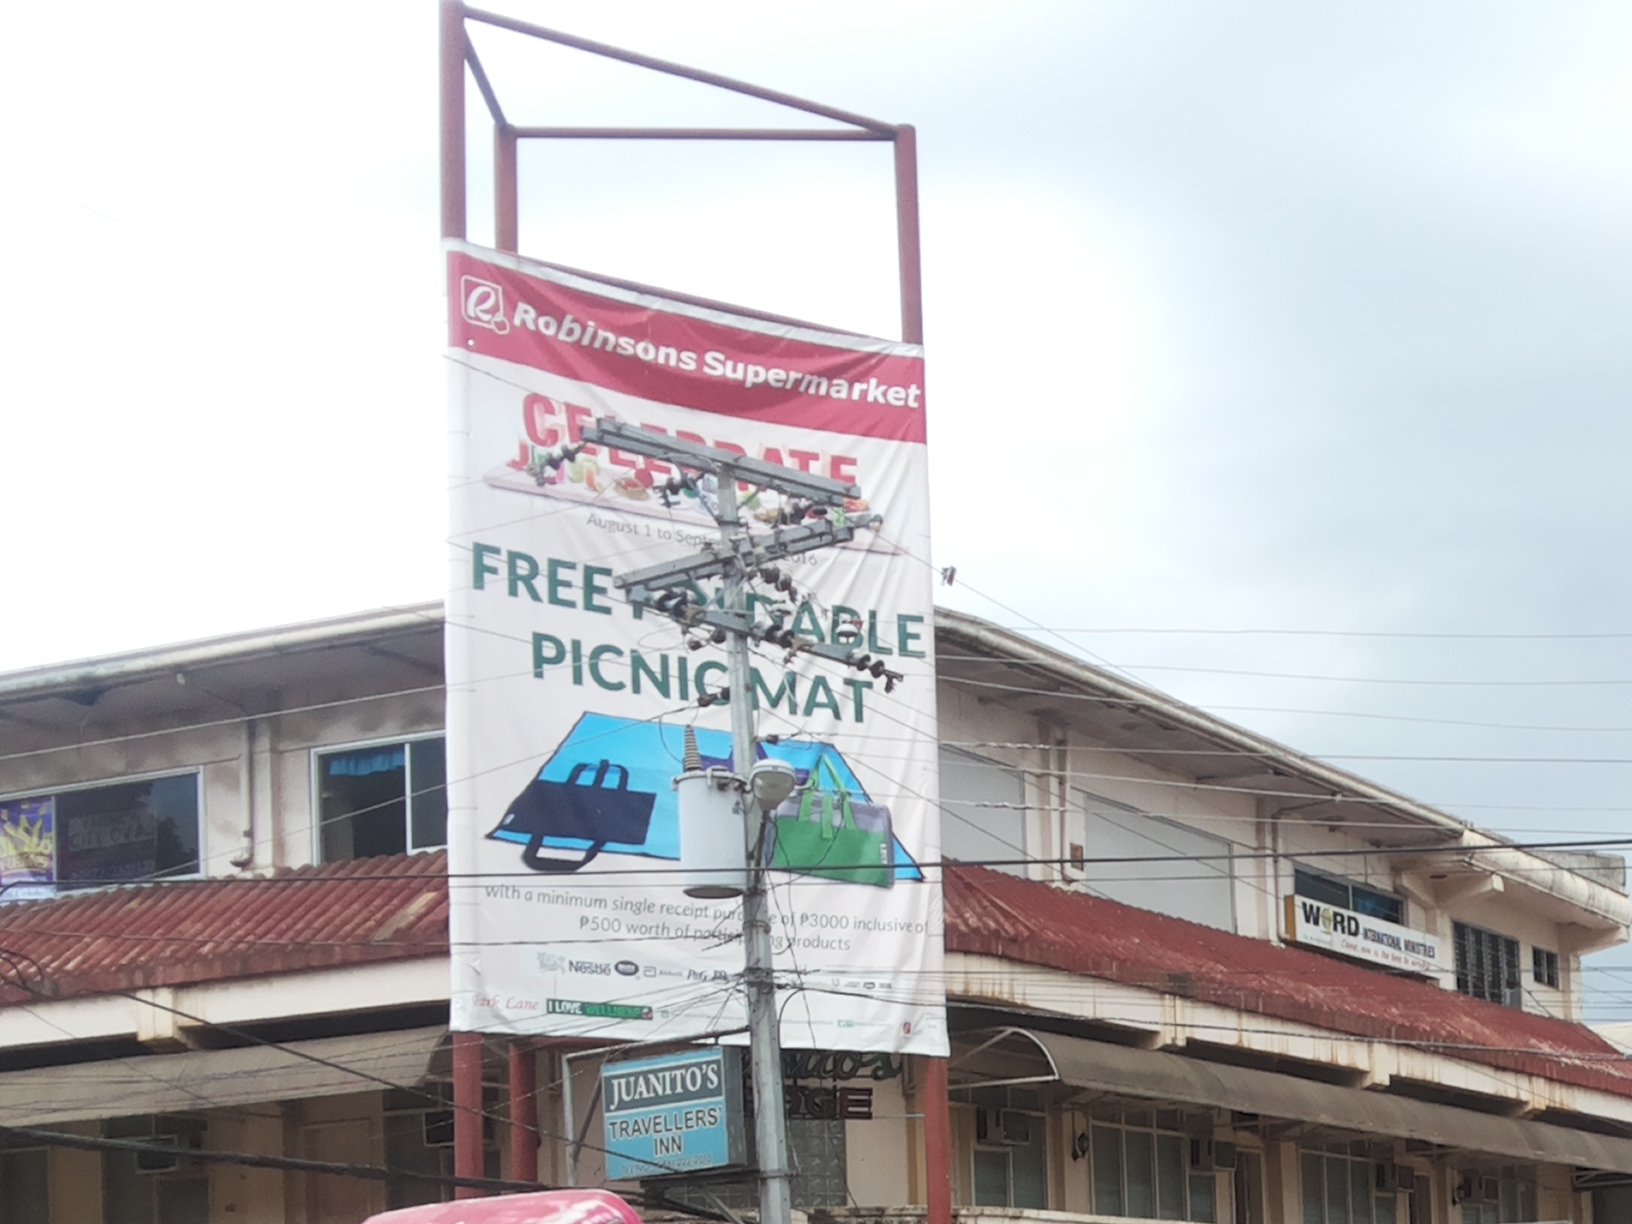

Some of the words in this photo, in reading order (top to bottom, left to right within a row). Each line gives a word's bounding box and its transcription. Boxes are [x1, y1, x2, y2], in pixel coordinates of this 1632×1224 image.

[514, 301, 697, 371] Robinsons
[703, 350, 922, 409] Supermarket
[586, 512, 639, 537] August
[657, 526, 672, 542] to
[471, 543, 613, 615] FREE
[531, 631, 731, 704] PICNIC
[750, 664, 874, 724] MAT
[524, 892, 533, 902] a
[537, 889, 608, 911] minimum
[612, 899, 655, 916] single
[660, 903, 708, 920] receipt
[853, 917, 912, 933] inclusive
[914, 920, 928, 933] of
[626, 923, 671, 939] worth
[675, 924, 691, 939] of
[789, 936, 851, 951] products
[555, 1001, 583, 1014] LOVE
[609, 1064, 719, 1111] JUANITO'S
[609, 1106, 722, 1140] TRAVELLERS'
[654, 1135, 683, 1156] INN
